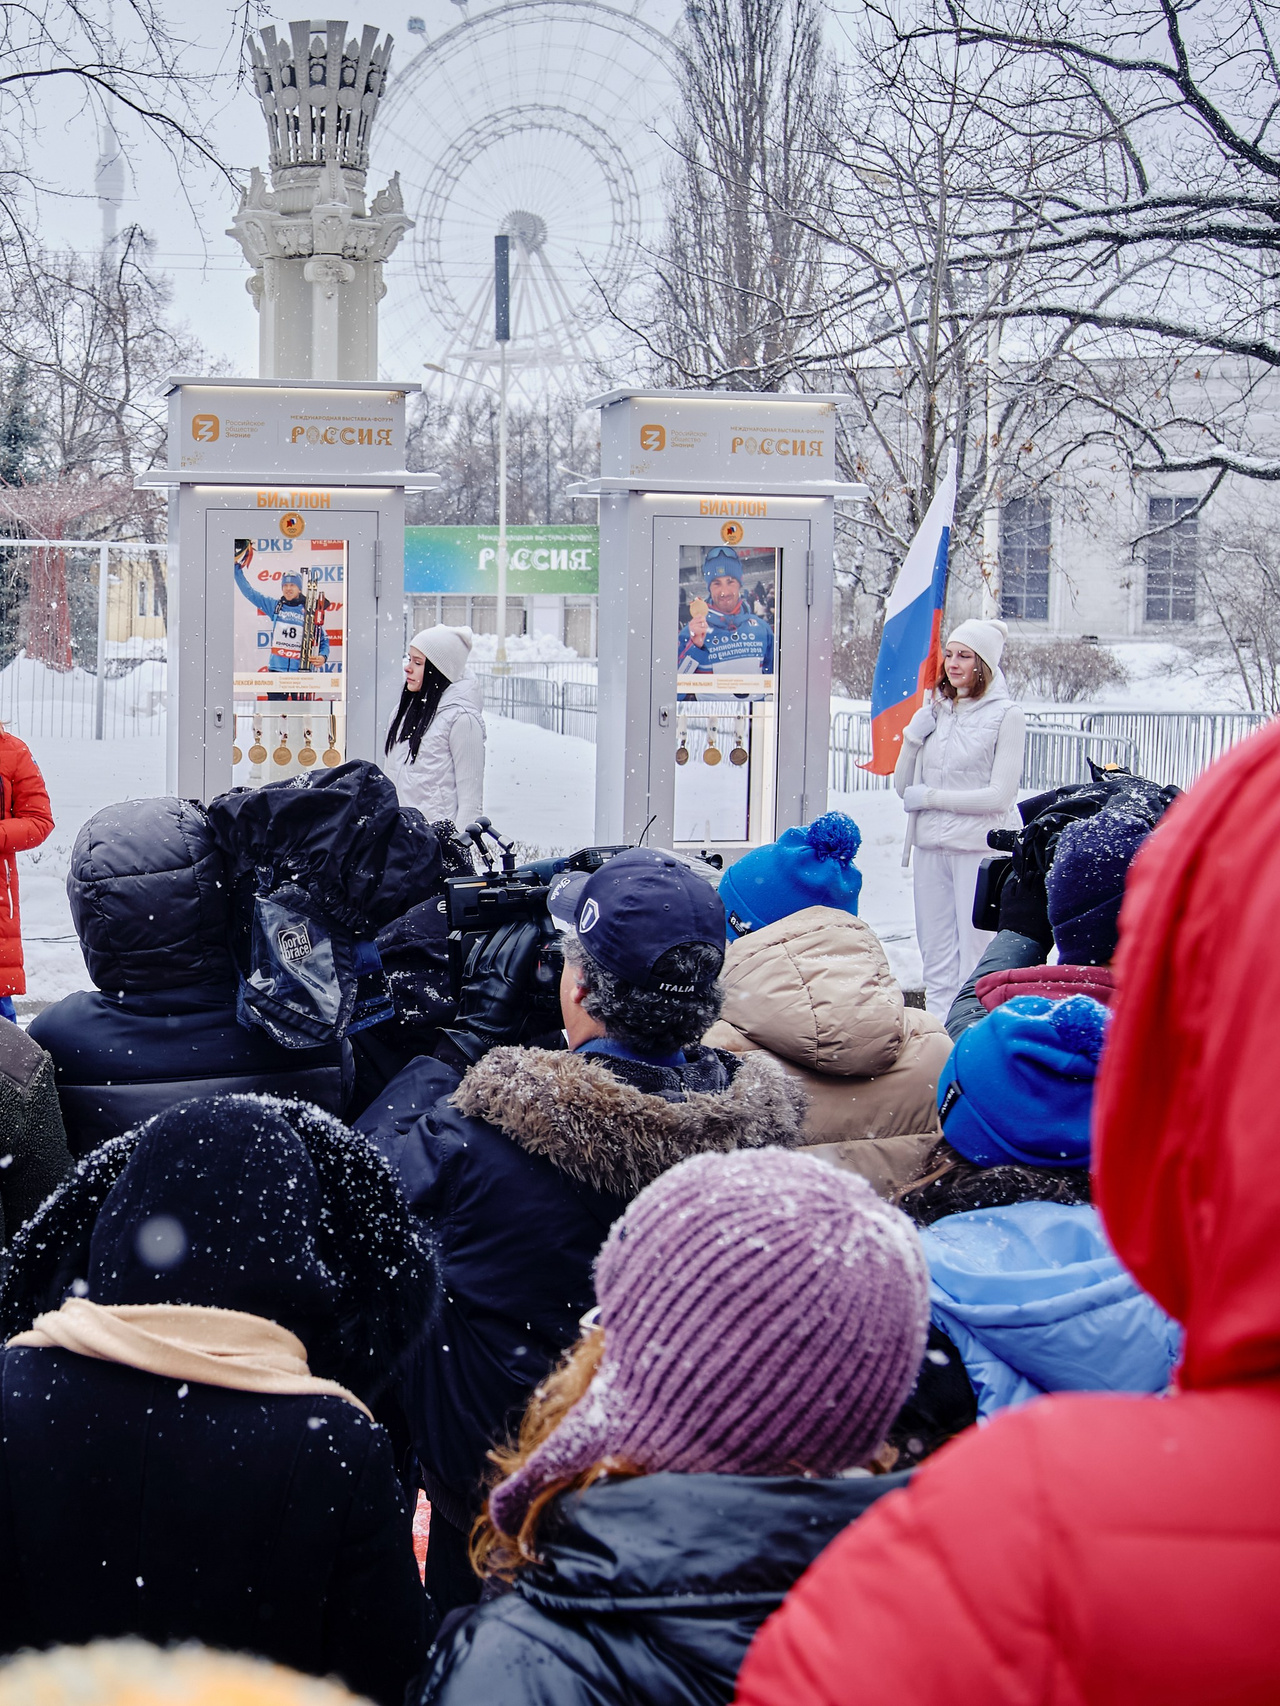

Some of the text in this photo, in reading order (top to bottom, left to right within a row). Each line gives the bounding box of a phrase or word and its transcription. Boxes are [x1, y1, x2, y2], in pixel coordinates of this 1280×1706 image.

[290, 426, 393, 446] РОССИЯ
[731, 436, 824, 457] РОССИЯ
[256, 490, 331, 509] БИАТЛОН
[699, 499, 767, 517] БИАТЛОН
[257, 539, 293, 552] DKB
[281, 627, 297, 639] 48
[282, 933, 308, 950] porta
[285, 944, 310, 960] brace
[659, 982, 695, 993] ITALIA
